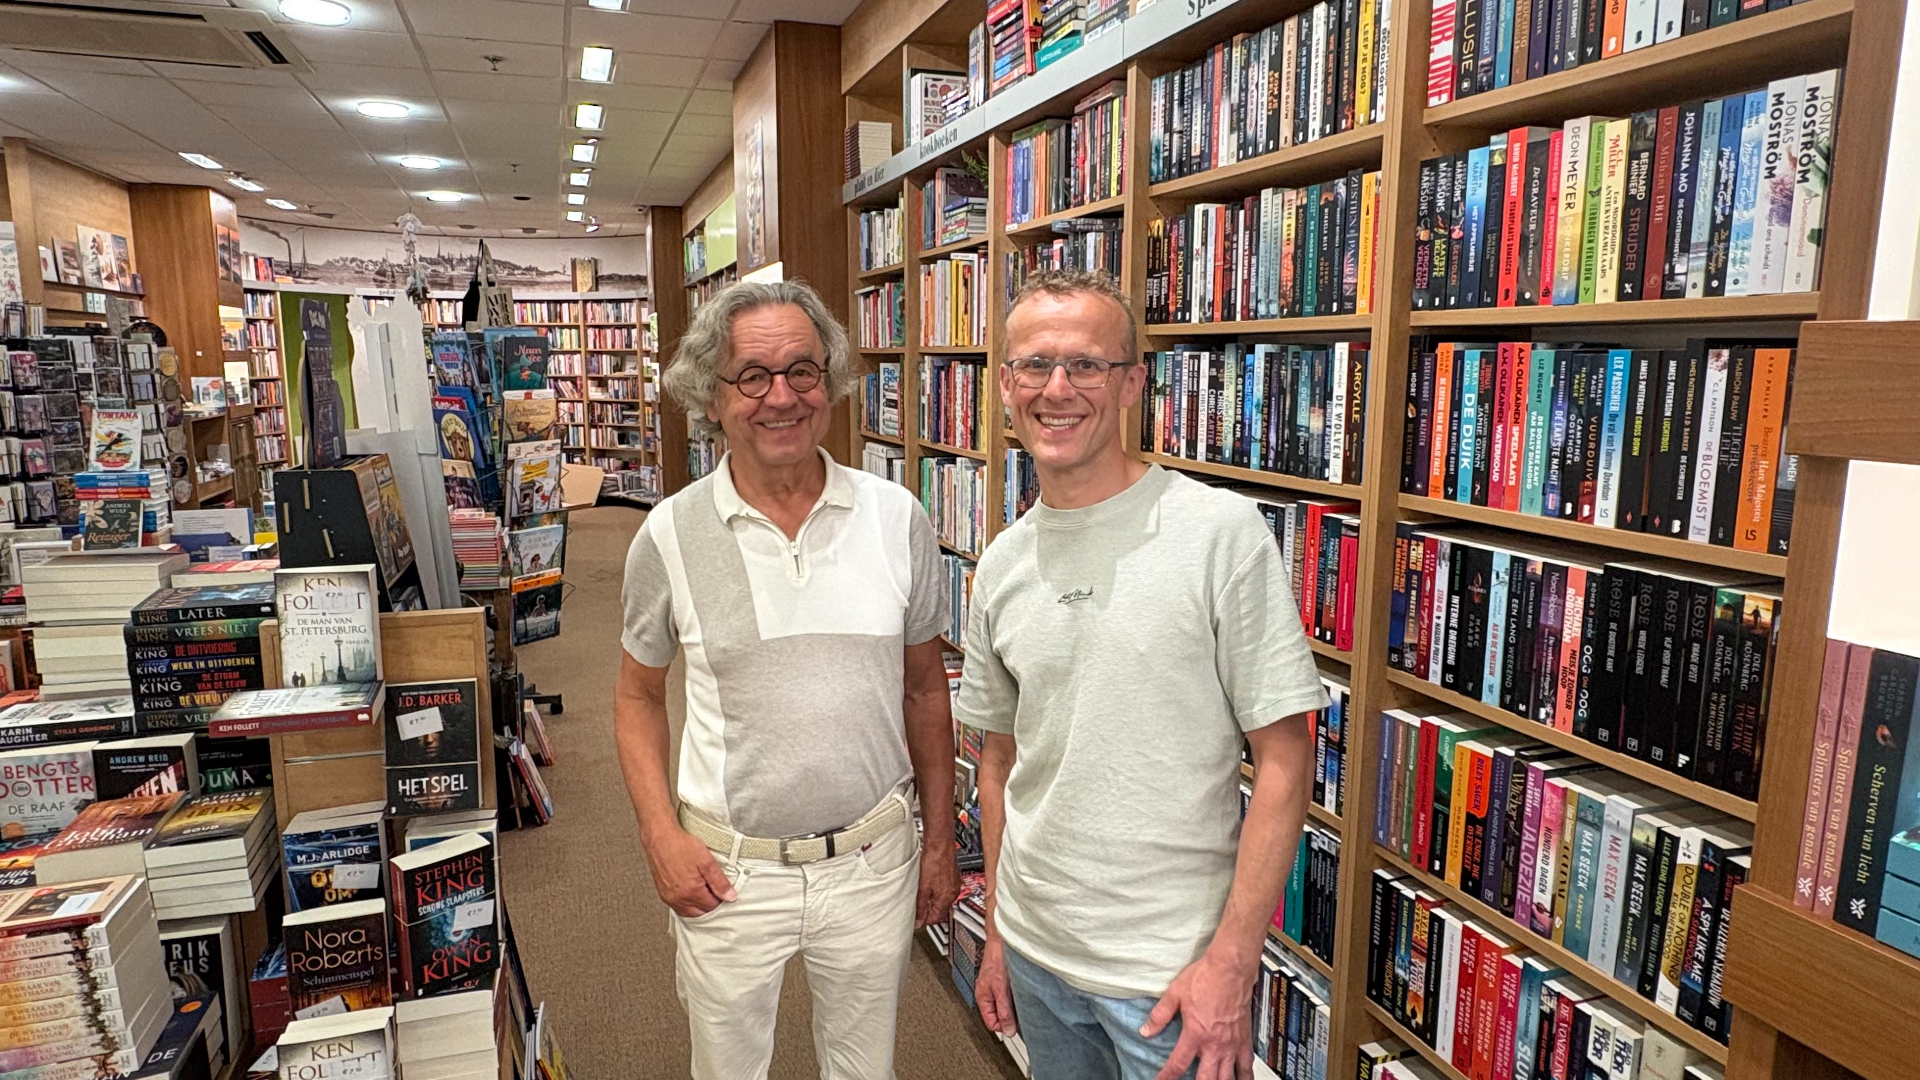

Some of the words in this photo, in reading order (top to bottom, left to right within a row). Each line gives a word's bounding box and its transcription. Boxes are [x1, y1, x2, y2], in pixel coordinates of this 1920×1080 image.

[1362, 52, 1368, 64] JE
[1379, 27, 1387, 97] DOODLOOPT
[1782, 100, 1798, 144] JONAS
[1796, 86, 1820, 185] MOSTRÖM
[1816, 95, 1834, 144] JONAS
[920, 127, 957, 159] kookboeken
[1680, 111, 1696, 171] JOHANNA
[1764, 92, 1786, 180] MOSTRÖM
[853, 180, 865, 197] plant
[874, 167, 884, 182] dier
[1419, 167, 1431, 216] MARSONS
[1436, 162, 1448, 213] MARSONS
[1453, 160, 1464, 202] MARSONS
[1628, 160, 1640, 195] MINIER
[1636, 152, 1650, 200] BERNARD
[1678, 172, 1690, 193] MO
[1678, 198, 1685, 208] DE
[1468, 223, 1477, 272] APPELMEISJE
[1625, 207, 1641, 271] STRIJDER
[1671, 209, 1683, 266] OCHTENDNEVEL
[1415, 245, 1424, 289] VERLEDEN
[1422, 244, 1430, 289] VERGETEN
[1432, 239, 1441, 277] BELOFTE
[1438, 238, 1447, 277] LAATSTE
[1176, 251, 1184, 308] NOODSEIN
[1410, 372, 1418, 397] NOORT
[1578, 367, 1587, 405] NATHALIE
[1639, 360, 1649, 380] JAMES
[1667, 360, 1677, 381] JAMES
[1336, 395, 1343, 408] DE
[1352, 361, 1362, 423] ARGYLLE
[1536, 372, 1544, 404] NUGENT
[1589, 375, 1597, 398] PAGIE
[1595, 368, 1604, 407] NATHALIE
[1635, 381, 1646, 415] PATTERSON
[1663, 382, 1676, 417] PATTERSON
[1464, 393, 1476, 418] DE
[1537, 416, 1544, 426] DE
[1332, 413, 1342, 460] WOLVEN
[1565, 414, 1576, 465] OOSTHOEK
[1574, 418, 1583, 462] CAMPING
[1634, 416, 1643, 436] CROSS
[1660, 418, 1672, 453] LUCHTDOEL
[1460, 424, 1473, 470] DUIK
[1534, 428, 1543, 464] DONKERE
[1583, 416, 1598, 494] VUURDUIVEL
[1632, 437, 1641, 456] DOWN
[88, 531, 131, 544] Reiziger
[1305, 558, 1315, 617] APPARTEMENT
[139, 615, 168, 623] KING
[179, 608, 226, 620] LATER
[297, 617, 309, 626] DE
[310, 617, 332, 625] MAN
[333, 616, 353, 625] VAN
[1450, 595, 1460, 628] INTERNE
[1562, 587, 1576, 643] ROBOTHAM
[1572, 595, 1584, 638] MICHAEL
[136, 633, 168, 643] KING
[175, 627, 214, 637] VREES
[217, 624, 249, 633] NIET
[284, 626, 298, 636] ST.
[301, 624, 367, 636] PETERSBURG
[135, 650, 168, 659] KING
[1446, 630, 1457, 665] DREIGING
[1567, 649, 1578, 677] MEISJE
[1712, 634, 1725, 684] ROSENBERG
[136, 665, 167, 675] KING
[171, 661, 193, 671] WERK
[195, 660, 205, 668] IN
[1740, 640, 1753, 691] ROSENBERG
[140, 681, 182, 694] KING
[398, 696, 417, 707] J.D.
[418, 693, 462, 706] BARKER
[1565, 678, 1575, 710] ZONDER
[142, 700, 173, 709] KING
[0, 727, 33, 738] KARIN
[218, 724, 233, 732] KEN
[233, 722, 260, 732] FOLLETT
[4, 760, 80, 780] BENGTS
[109, 754, 146, 765] ANDREW
[148, 753, 169, 763] REID
[1811, 740, 1830, 797] Splinters
[397, 777, 430, 796] HET
[431, 773, 468, 791] SPEL
[1833, 747, 1852, 804] Splinters
[8, 803, 26, 815] DE
[30, 801, 66, 814] RAAF
[1866, 765, 1887, 824] Scherven
[1808, 800, 1820, 822] van
[1829, 808, 1842, 830] van
[296, 852, 318, 864] M.J.
[321, 845, 371, 860] ARLIDGE
[1541, 826, 1553, 865] HONDERD
[1581, 830, 1594, 854] MAX
[1800, 825, 1817, 870] genade
[1821, 832, 1838, 878] genade
[1860, 828, 1874, 851] van
[414, 853, 484, 886] STEPHEN
[1517, 821, 1537, 904] JALOEZIE
[1577, 855, 1592, 890] SEECK
[1633, 853, 1648, 881] MAX
[1855, 854, 1873, 884] licht
[416, 865, 486, 907] KING
[445, 886, 485, 907] SLAAPSTERS
[1538, 867, 1549, 895] DAGEN
[1575, 893, 1585, 930] RANCUNE
[1628, 882, 1645, 918] SEECK
[1702, 897, 1713, 908] A
[1700, 910, 1711, 933] SPY
[304, 928, 366, 951] Nora
[432, 935, 481, 962] OWEN
[1694, 938, 1708, 961] LIKE
[290, 945, 384, 974] Roberts
[422, 942, 492, 985] KING
[1690, 964, 1703, 983] ME
[302, 967, 376, 986] Schimmenspel
[148, 1047, 179, 1063] DE
[310, 1039, 355, 1062] KEN
[1592, 1025, 1606, 1061] THOR
[1612, 1038, 1627, 1074] THOR
